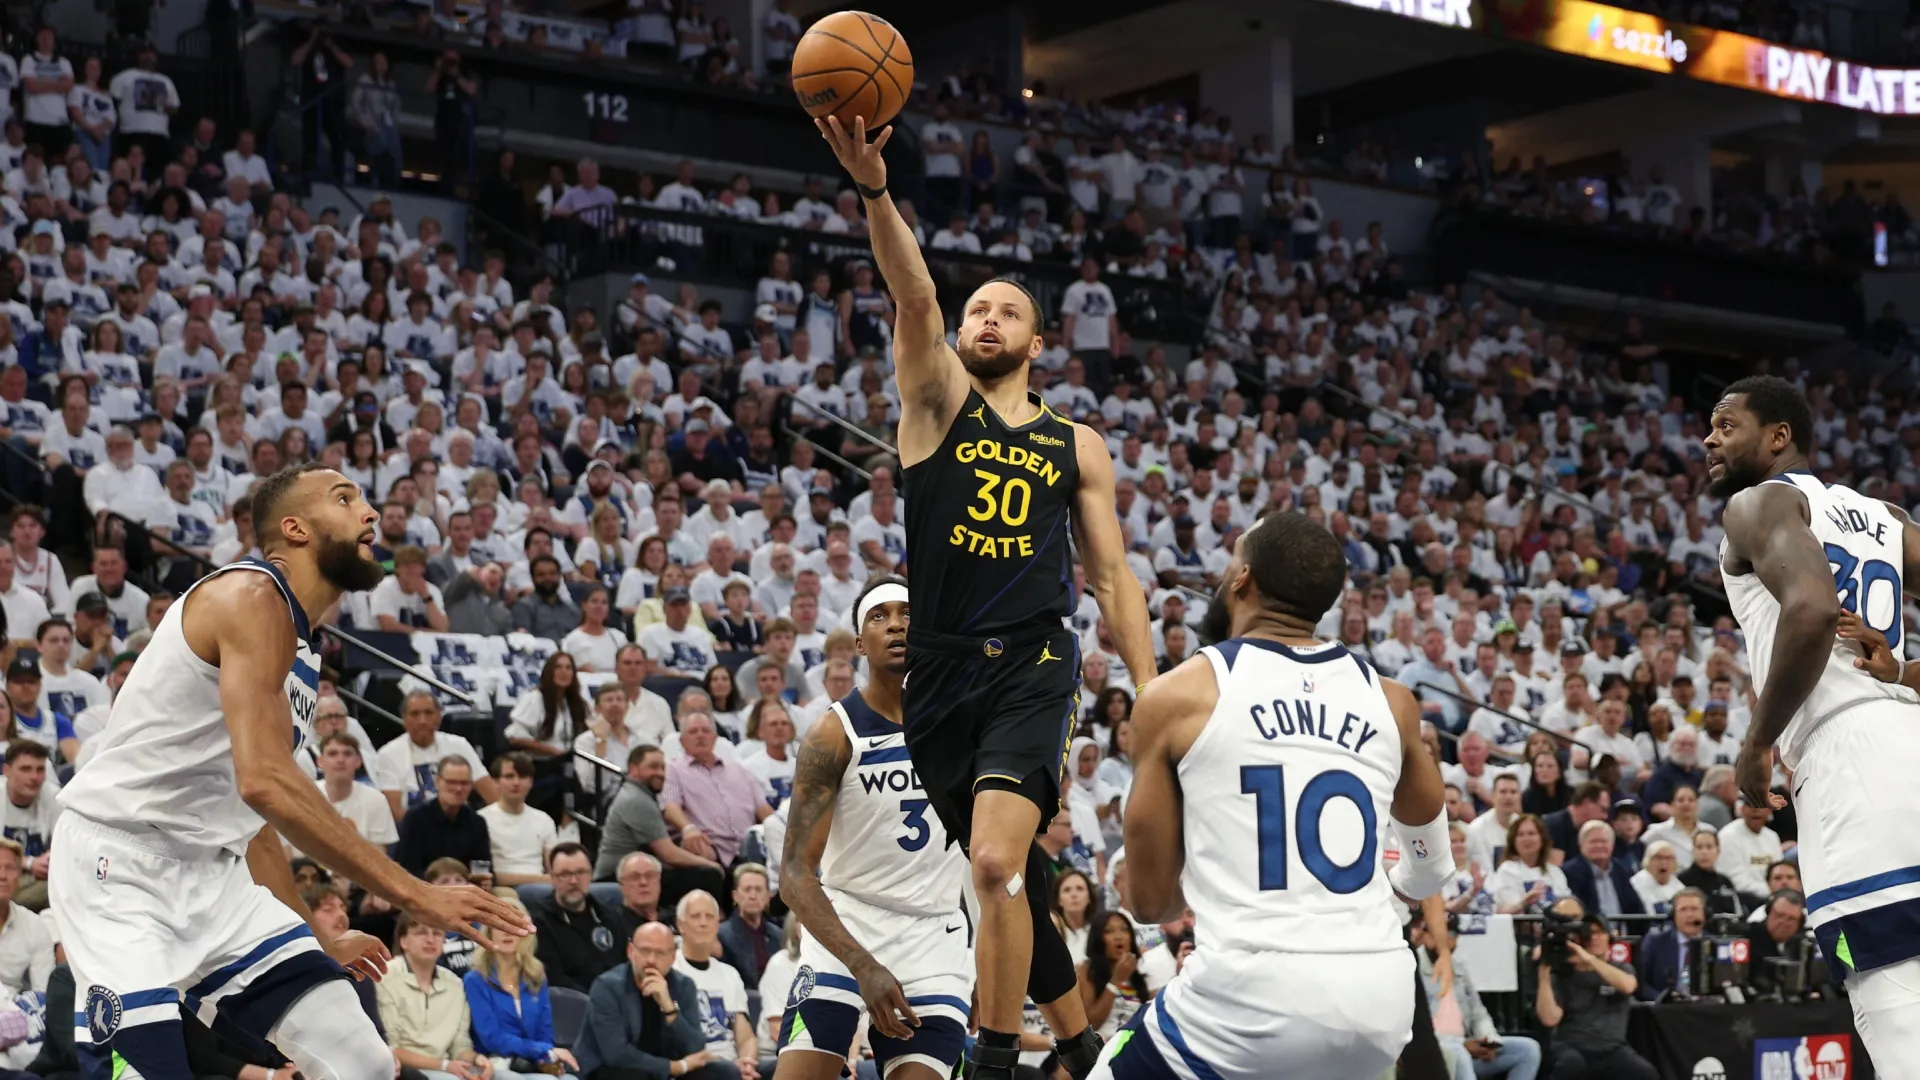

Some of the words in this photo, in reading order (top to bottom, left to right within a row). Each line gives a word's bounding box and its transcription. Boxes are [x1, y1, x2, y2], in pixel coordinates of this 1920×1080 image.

[1612, 26, 1687, 62] sezzle
[1767, 46, 1831, 100] PAY
[582, 91, 629, 121] 112
[956, 439, 1061, 487] GOLDEN
[1029, 432, 1065, 447] Rakuten
[967, 468, 1031, 526] 30
[950, 524, 1033, 558] STATE
[1250, 699, 1378, 754] CONLEY
[897, 799, 930, 852] 3
[1240, 764, 1378, 894] 10
